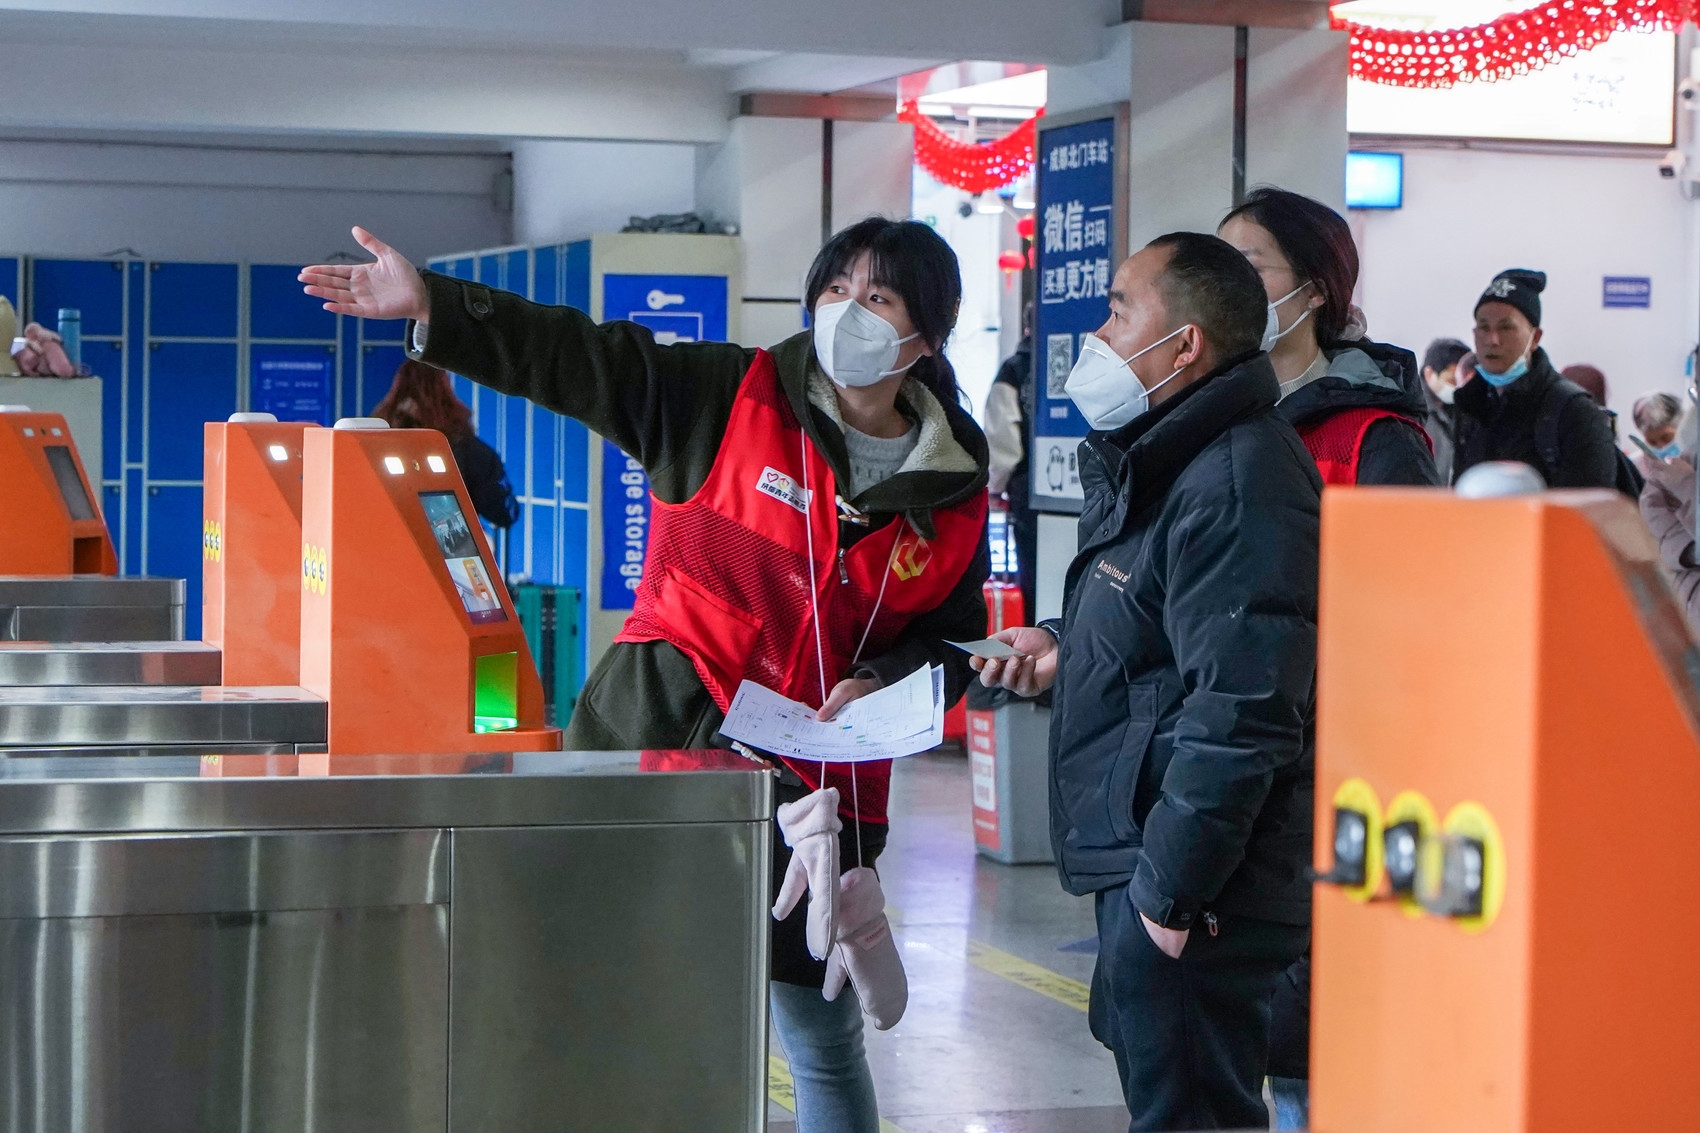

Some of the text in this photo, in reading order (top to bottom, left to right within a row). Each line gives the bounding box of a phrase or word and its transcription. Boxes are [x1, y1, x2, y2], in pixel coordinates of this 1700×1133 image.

[1049, 139, 1109, 172] 成都北门车站
[619, 503, 647, 590] storage
[1097, 559, 1129, 583] Ambitous
